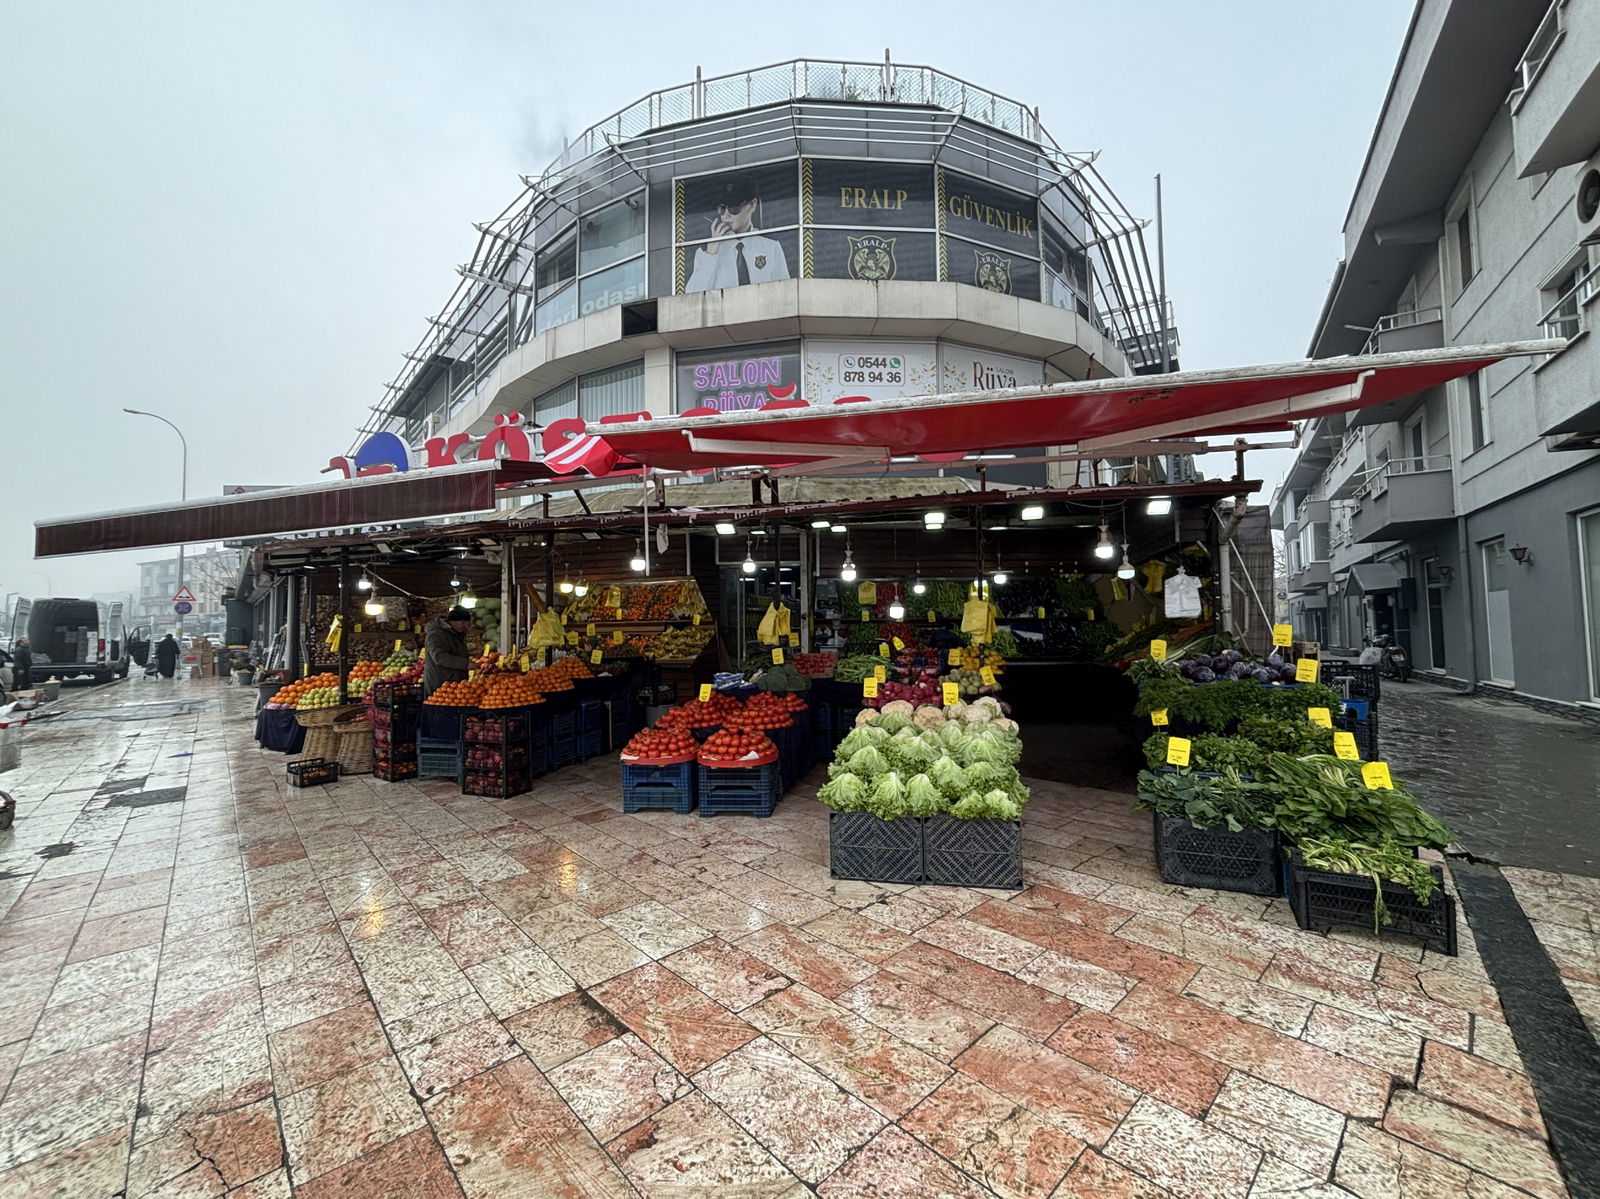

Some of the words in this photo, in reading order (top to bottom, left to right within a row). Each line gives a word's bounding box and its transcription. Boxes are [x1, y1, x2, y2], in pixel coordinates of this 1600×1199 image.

[840, 187, 908, 210] ERALP
[949, 195, 1033, 239] GÜVENLİK
[857, 239, 888, 250] ERALP
[981, 255, 1007, 268] ERALP
[857, 357, 887, 369] 0544
[693, 356, 781, 389] SALON
[843, 370, 867, 384] 878
[868, 370, 884, 384] 94
[885, 370, 902, 384] 36
[995, 366, 1014, 376] SALON
